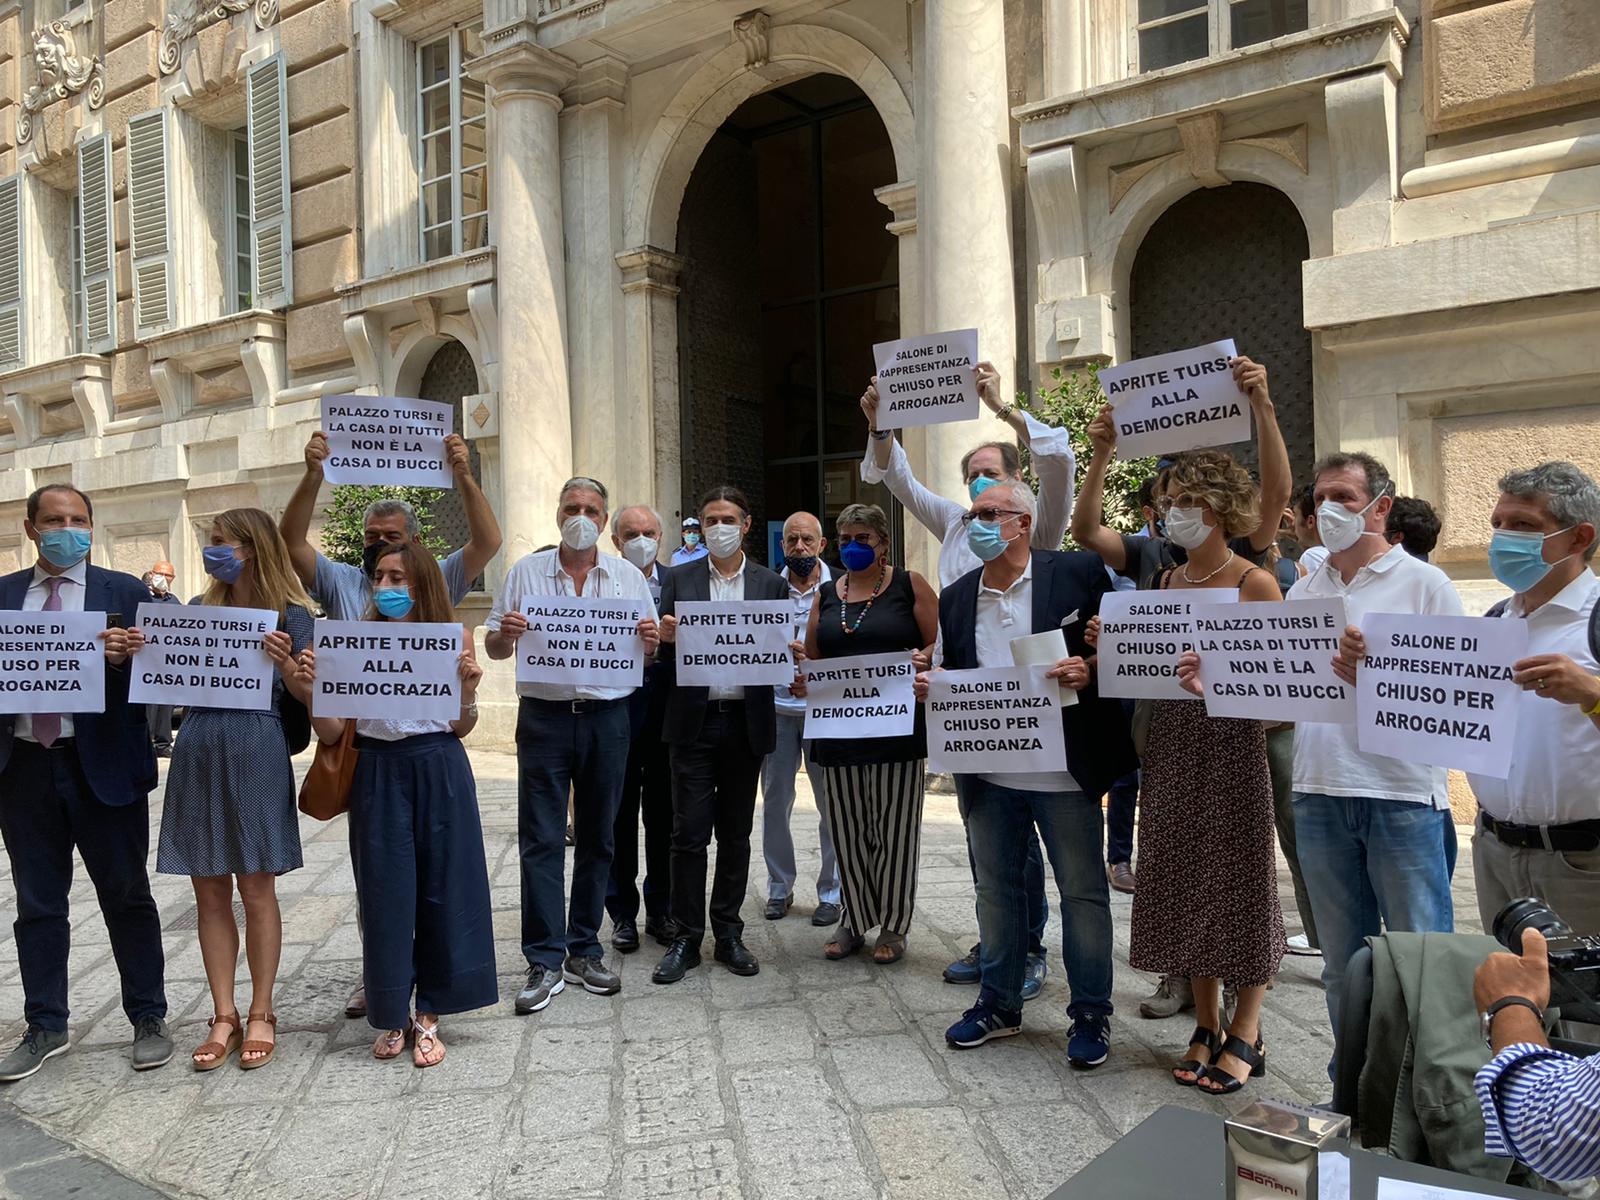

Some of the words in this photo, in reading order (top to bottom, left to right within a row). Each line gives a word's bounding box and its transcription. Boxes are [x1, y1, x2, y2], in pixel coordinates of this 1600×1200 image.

[896, 347, 934, 361] SALONE
[937, 344, 947, 354] DI
[879, 357, 971, 379] RAPPRESENTANZA
[889, 378, 934, 394] CHIUSO
[938, 374, 963, 387] PER
[1109, 371, 1170, 394] APRITE
[889, 393, 965, 411] ARROGANZA
[1151, 388, 1200, 408] ALLA
[329, 407, 389, 418] PALAZZO
[394, 410, 432, 421] TURSI
[437, 411, 445, 422] È
[1120, 403, 1242, 437] DEMOCRAZIA
[329, 423, 345, 432] LA
[349, 423, 385, 434] CASA
[389, 426, 401, 434] DI
[406, 426, 444, 437] TUTTI
[351, 440, 385, 451] NON
[390, 438, 398, 451] È
[404, 441, 423, 452] LA
[330, 457, 371, 468] CASA
[376, 459, 391, 469] DI
[396, 459, 443, 471] BUCCI
[527, 607, 585, 618] PALAZZO
[590, 610, 627, 621] TURSI
[631, 609, 639, 620] È
[1129, 604, 1181, 616] SALONE
[143, 617, 206, 629] PALAZZO
[210, 620, 253, 632] TURSI
[257, 621, 267, 633] È
[679, 614, 737, 626] APRITE
[741, 613, 790, 625] TURSI
[1197, 619, 1263, 631] PALAZZO
[1267, 616, 1318, 630] TURSI
[1323, 613, 1335, 628] È
[50, 625, 65, 634] DI
[527, 622, 542, 632] LA
[546, 623, 581, 634] CASA
[585, 625, 597, 634] DI
[164, 635, 201, 647] CASA
[205, 638, 218, 647] DI
[223, 638, 264, 650] TUTTI
[319, 636, 391, 650] APRITE
[397, 637, 456, 651] TURSI
[547, 639, 579, 651] NON
[584, 638, 593, 651] È
[598, 642, 616, 652] LA
[714, 634, 756, 645] ALLA
[1200, 640, 1219, 651] LA
[1222, 639, 1264, 651] CASA
[1268, 639, 1283, 650] DI
[1288, 638, 1338, 650] TUTTI
[1391, 633, 1456, 651] SALONE
[1461, 638, 1478, 652] DI
[1117, 642, 1177, 655] CHIUSO
[45, 660, 80, 671] PER
[165, 654, 199, 666] NON
[205, 653, 214, 667] È
[219, 656, 239, 669] LA
[362, 660, 413, 673] ALLA
[527, 655, 566, 668] CASA
[570, 658, 585, 668] DI
[590, 658, 634, 670] BUCCI
[683, 653, 788, 666] DEMOCRAZIA
[1229, 660, 1268, 674] NON
[1274, 658, 1285, 673] È
[1291, 660, 1315, 674] LA
[807, 668, 860, 682] APRITE
[864, 664, 911, 679] TURSI
[1364, 655, 1514, 681] RAPPRESENTANZA
[142, 673, 185, 686] CASA
[190, 675, 205, 687] DI
[210, 676, 261, 690] BUCCI
[322, 681, 452, 696] DEMOCRAZIA
[951, 681, 1002, 694] SALONE
[1007, 681, 1020, 691] DI
[842, 687, 881, 699] ALLA
[1213, 683, 1259, 697] CASA
[1263, 685, 1281, 697] DI
[1287, 685, 1345, 700] BUCCI
[1376, 682, 1447, 705] CHIUSO
[1454, 690, 1495, 711] PER
[812, 704, 908, 719] DEMOCRAZIA
[931, 697, 1052, 712] RAPPRESENTANZA
[944, 718, 1000, 731] CHIUSO
[1006, 716, 1039, 729] PER
[1375, 710, 1492, 742] ARROGANZA
[944, 738, 1043, 753] ARROGANZA
